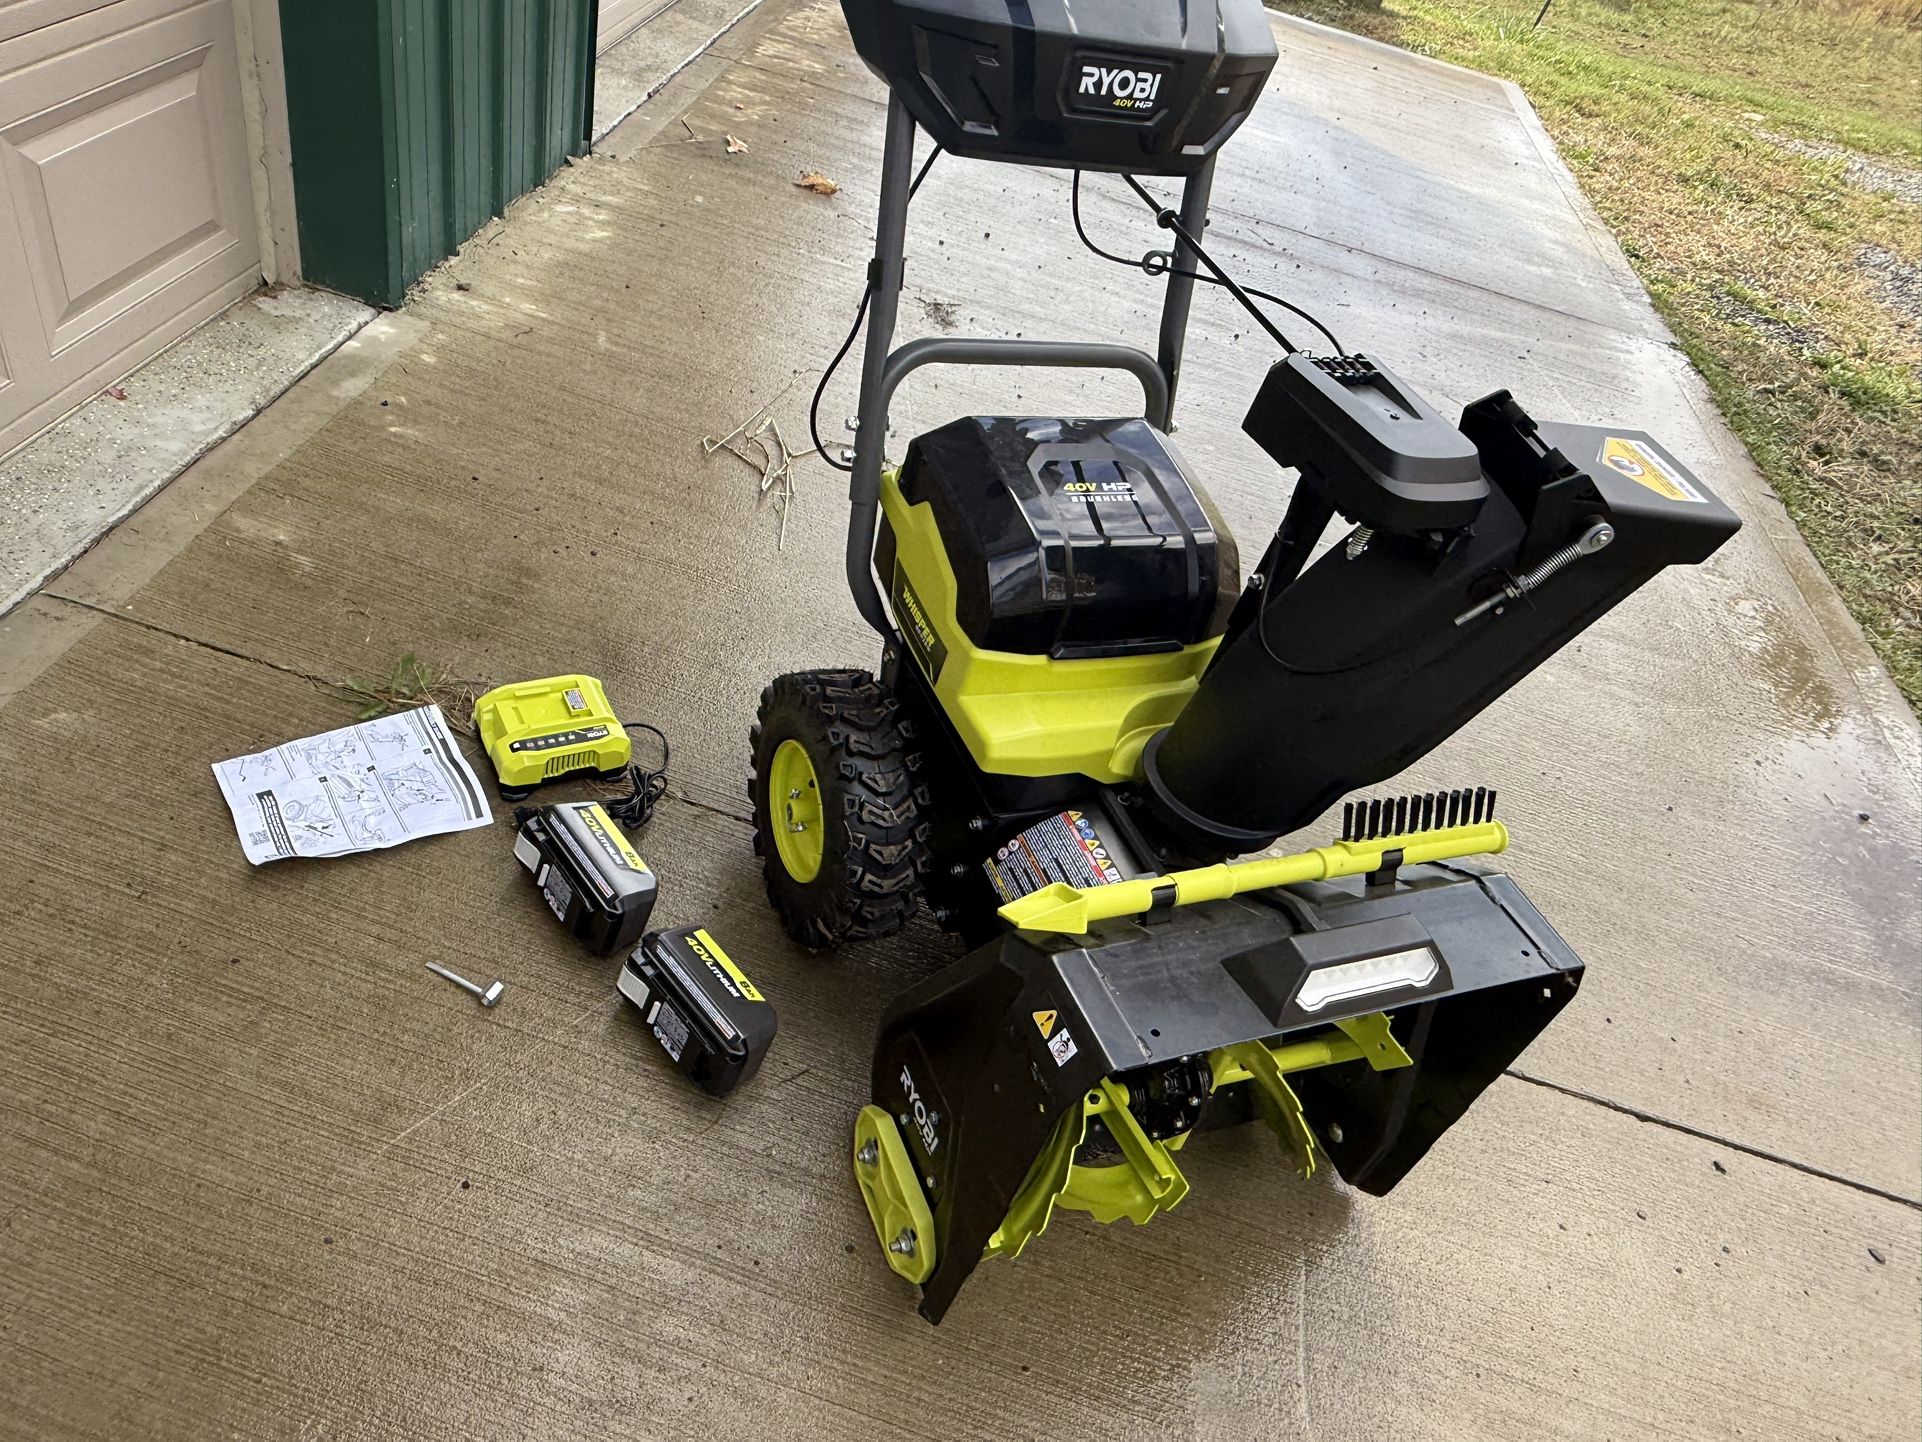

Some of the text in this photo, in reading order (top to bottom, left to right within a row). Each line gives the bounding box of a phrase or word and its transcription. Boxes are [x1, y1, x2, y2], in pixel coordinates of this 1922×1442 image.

[1079, 66, 1162, 100] RYOBI
[1113, 99, 1153, 109] 40V HP
[1063, 482, 1132, 492] 40V HP
[1071, 494, 1139, 503] BRUSHLESS
[903, 583, 935, 647] WHISPER
[685, 936, 714, 962] 40V
[900, 1065, 939, 1152] RYOBI
